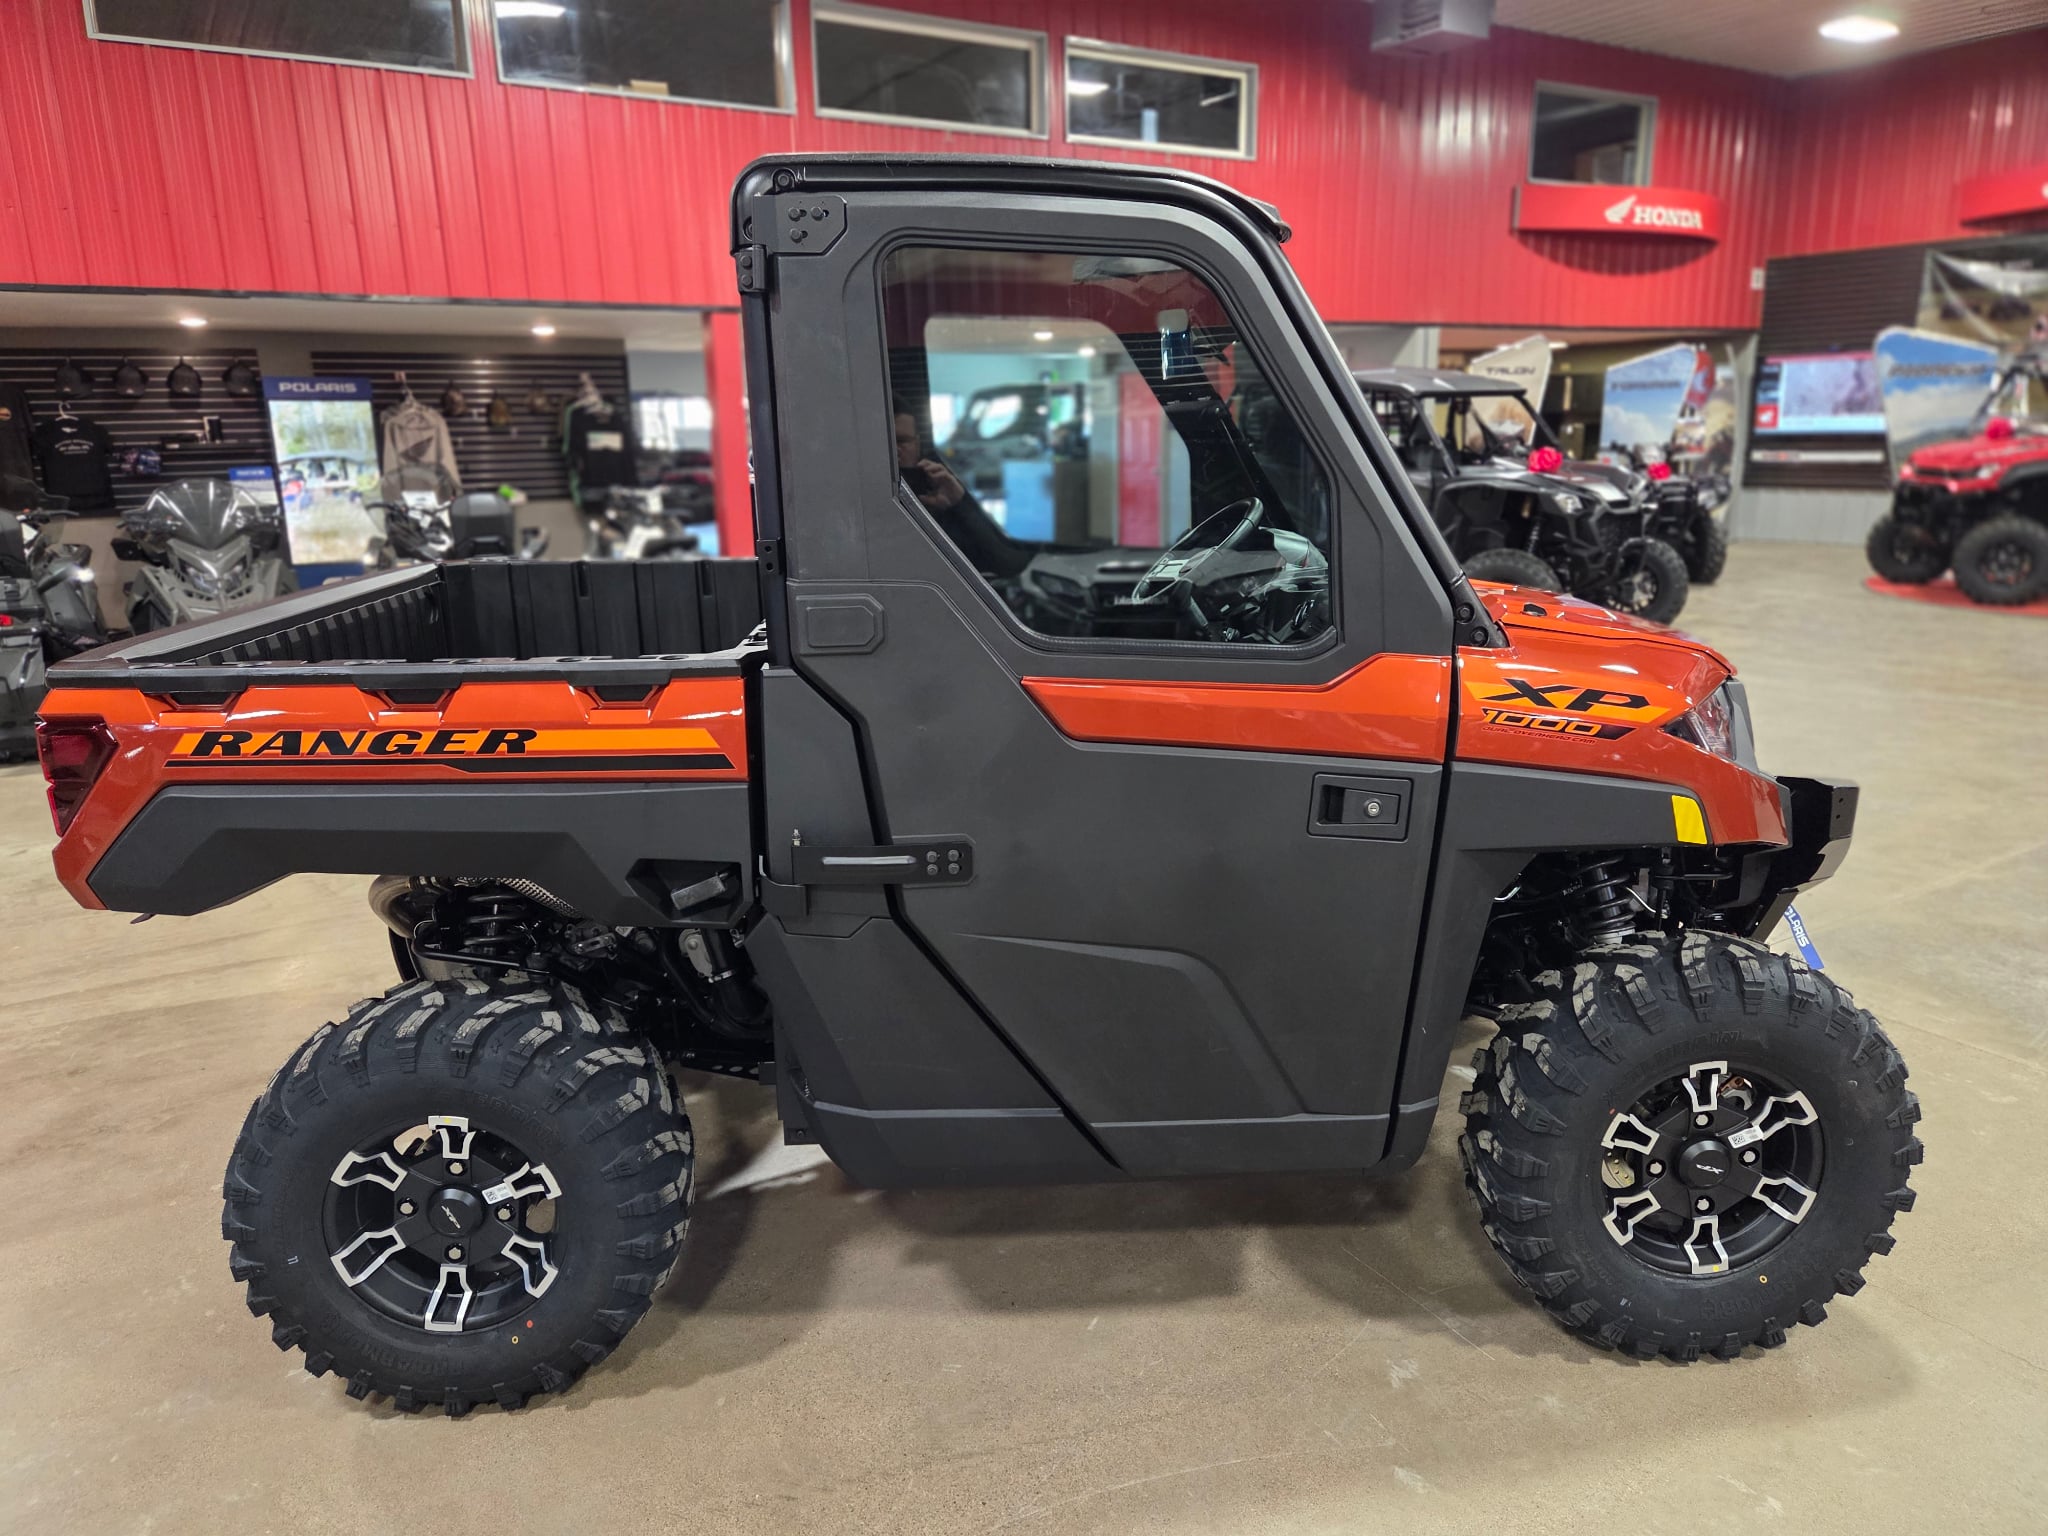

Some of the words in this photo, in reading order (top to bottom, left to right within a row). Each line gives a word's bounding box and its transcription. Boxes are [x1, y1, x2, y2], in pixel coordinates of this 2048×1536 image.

[1633, 205, 1703, 229] HONDA
[278, 382, 358, 393] POLARIS
[1478, 678, 1651, 712] XP
[1482, 710, 1602, 737] 1000
[188, 729, 538, 757] RANGER
[1784, 905, 1810, 948] OLARIS
